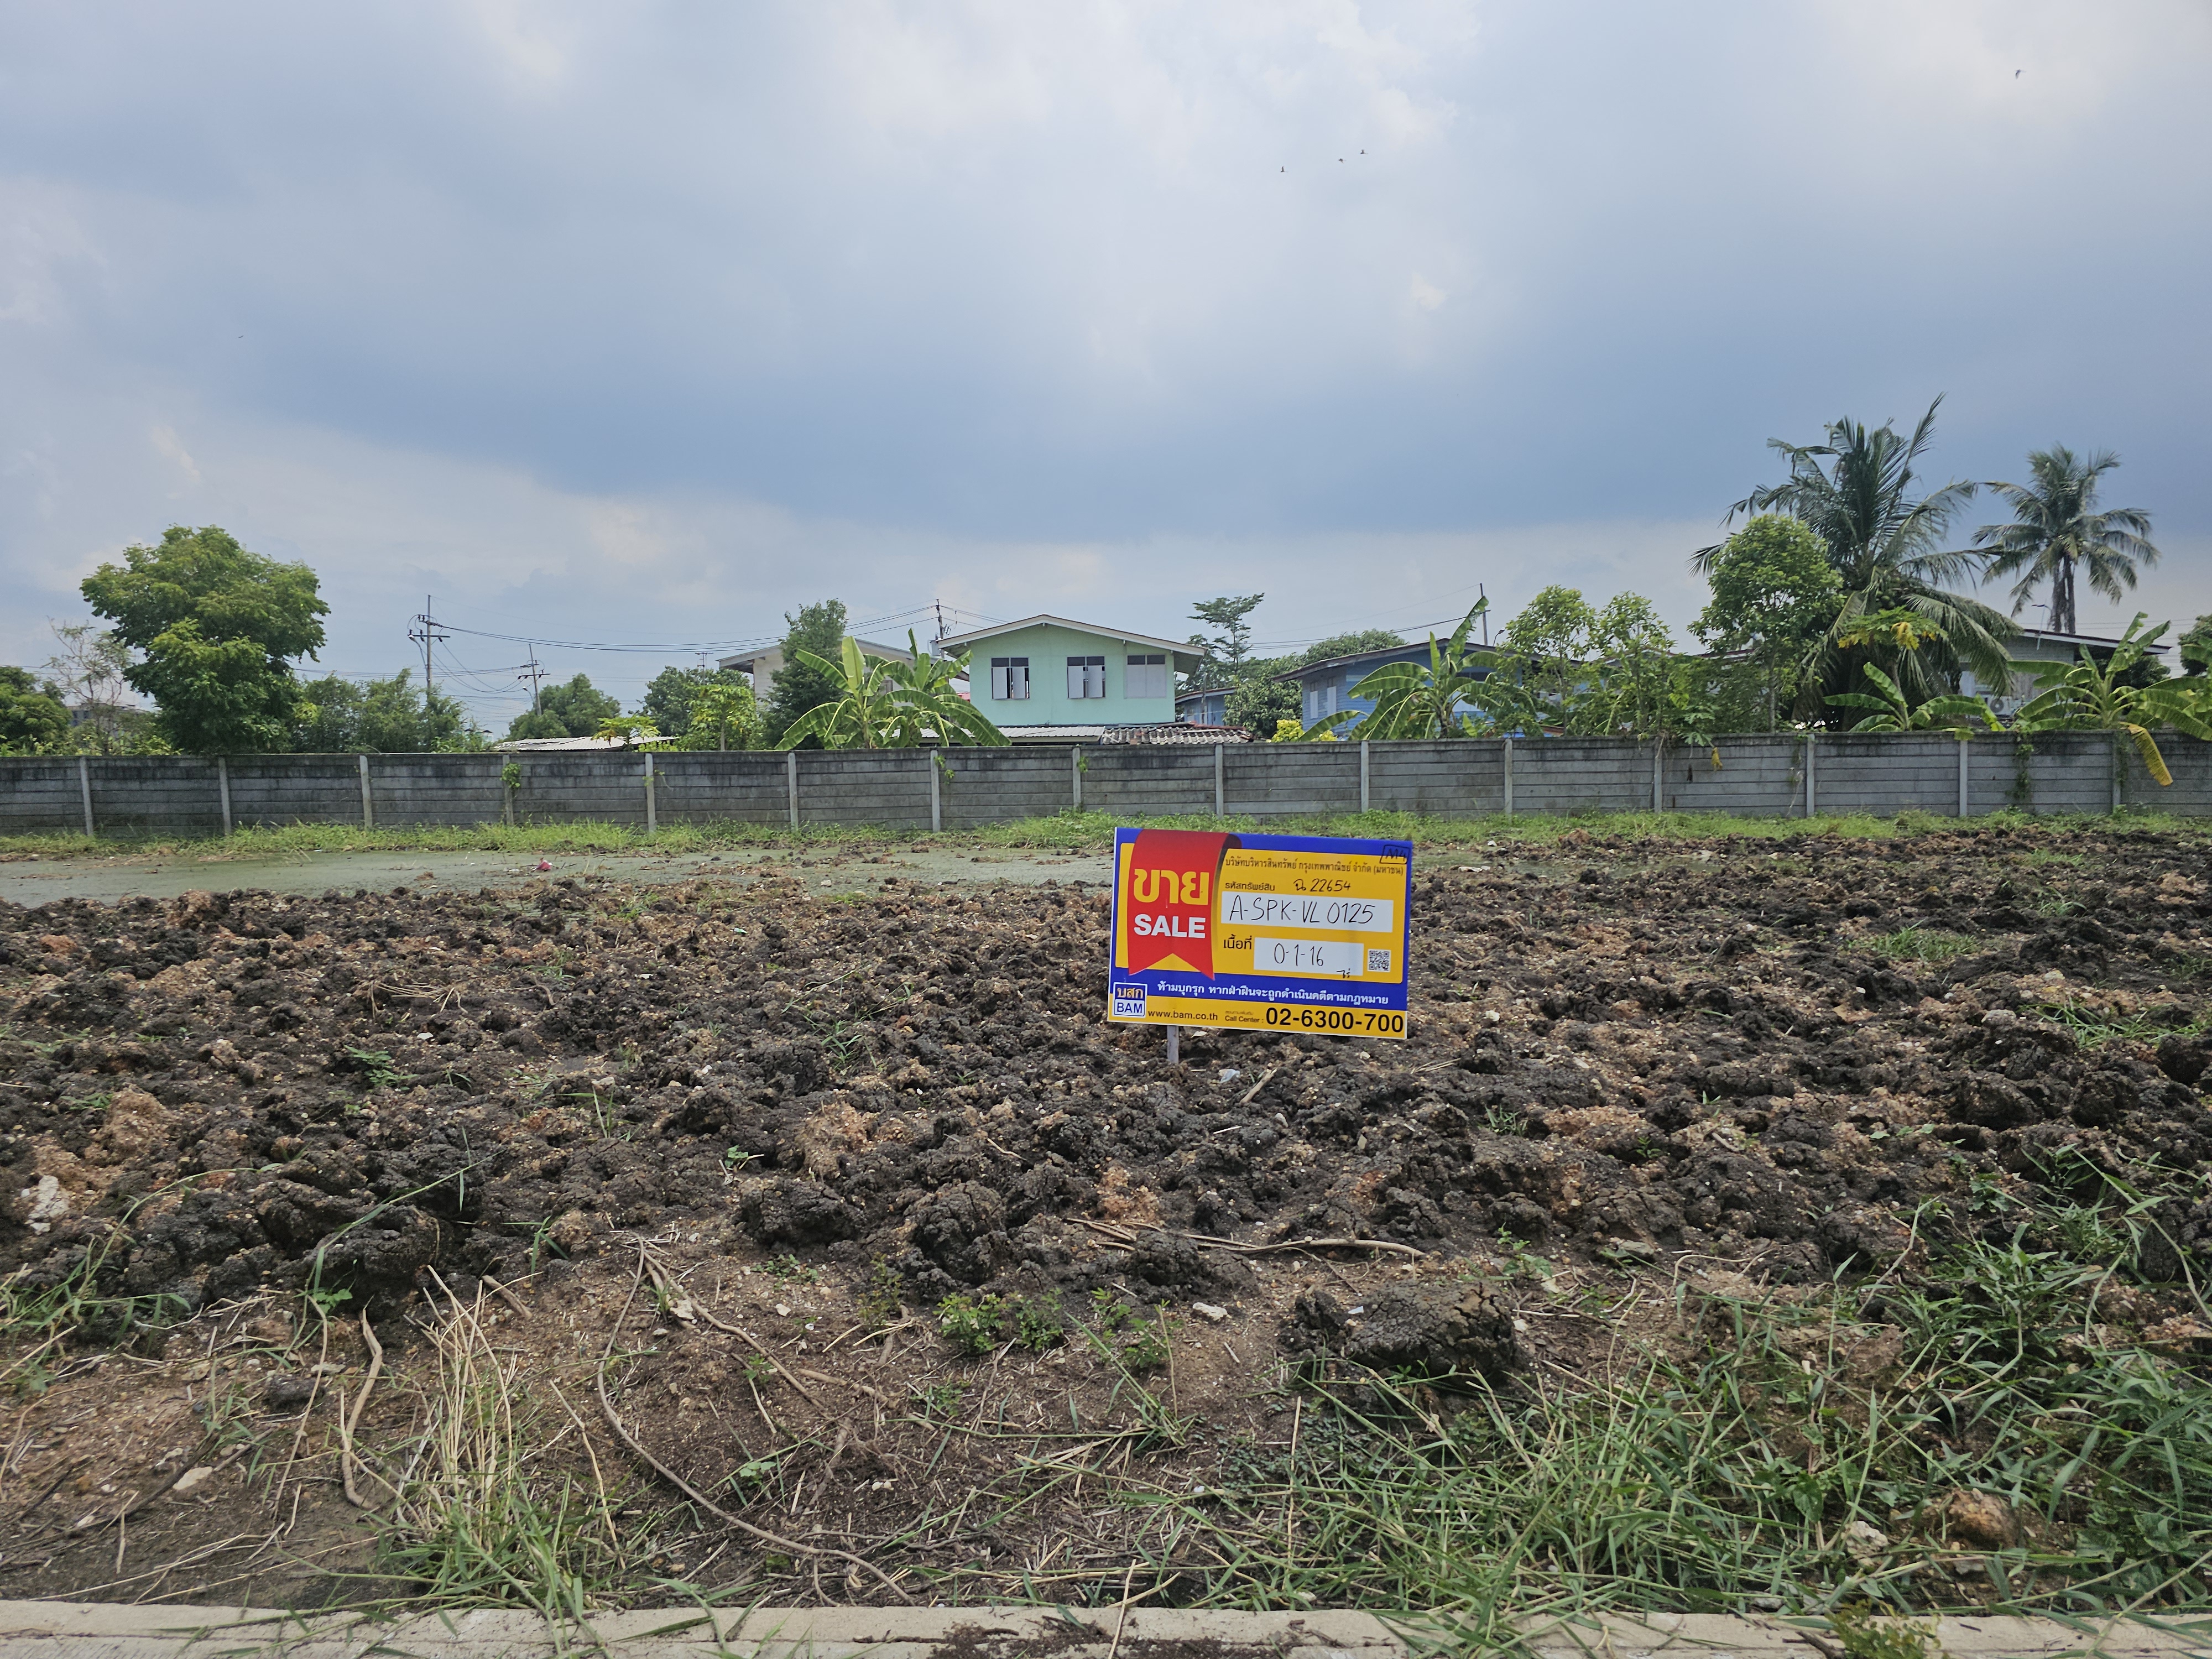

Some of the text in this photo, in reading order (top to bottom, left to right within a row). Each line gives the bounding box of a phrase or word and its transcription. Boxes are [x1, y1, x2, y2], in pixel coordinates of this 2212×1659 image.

[1225, 857, 1404, 876] บริษัทบริหารสินทรัพย์ กรุงเทพพาณิชย์ จำกัด (มหาชน)
[1133, 868, 1209, 905] ขาย
[1225, 881, 1275, 891] รหัสทรัพย์สิน
[1134, 914, 1206, 938] SALE
[1223, 933, 1253, 950] เนื้อที่
[1117, 987, 1144, 999] บสก
[1157, 980, 1389, 1005] ห้ามบุกรุก หากฝ่าฝืนจะถูกดำเนินคดีตามกฎหมาย
[1117, 1002, 1143, 1014] BAM
[1147, 1009, 1218, 1020] www.bam.co.th
[1266, 1007, 1404, 1032] 02-6300-700
